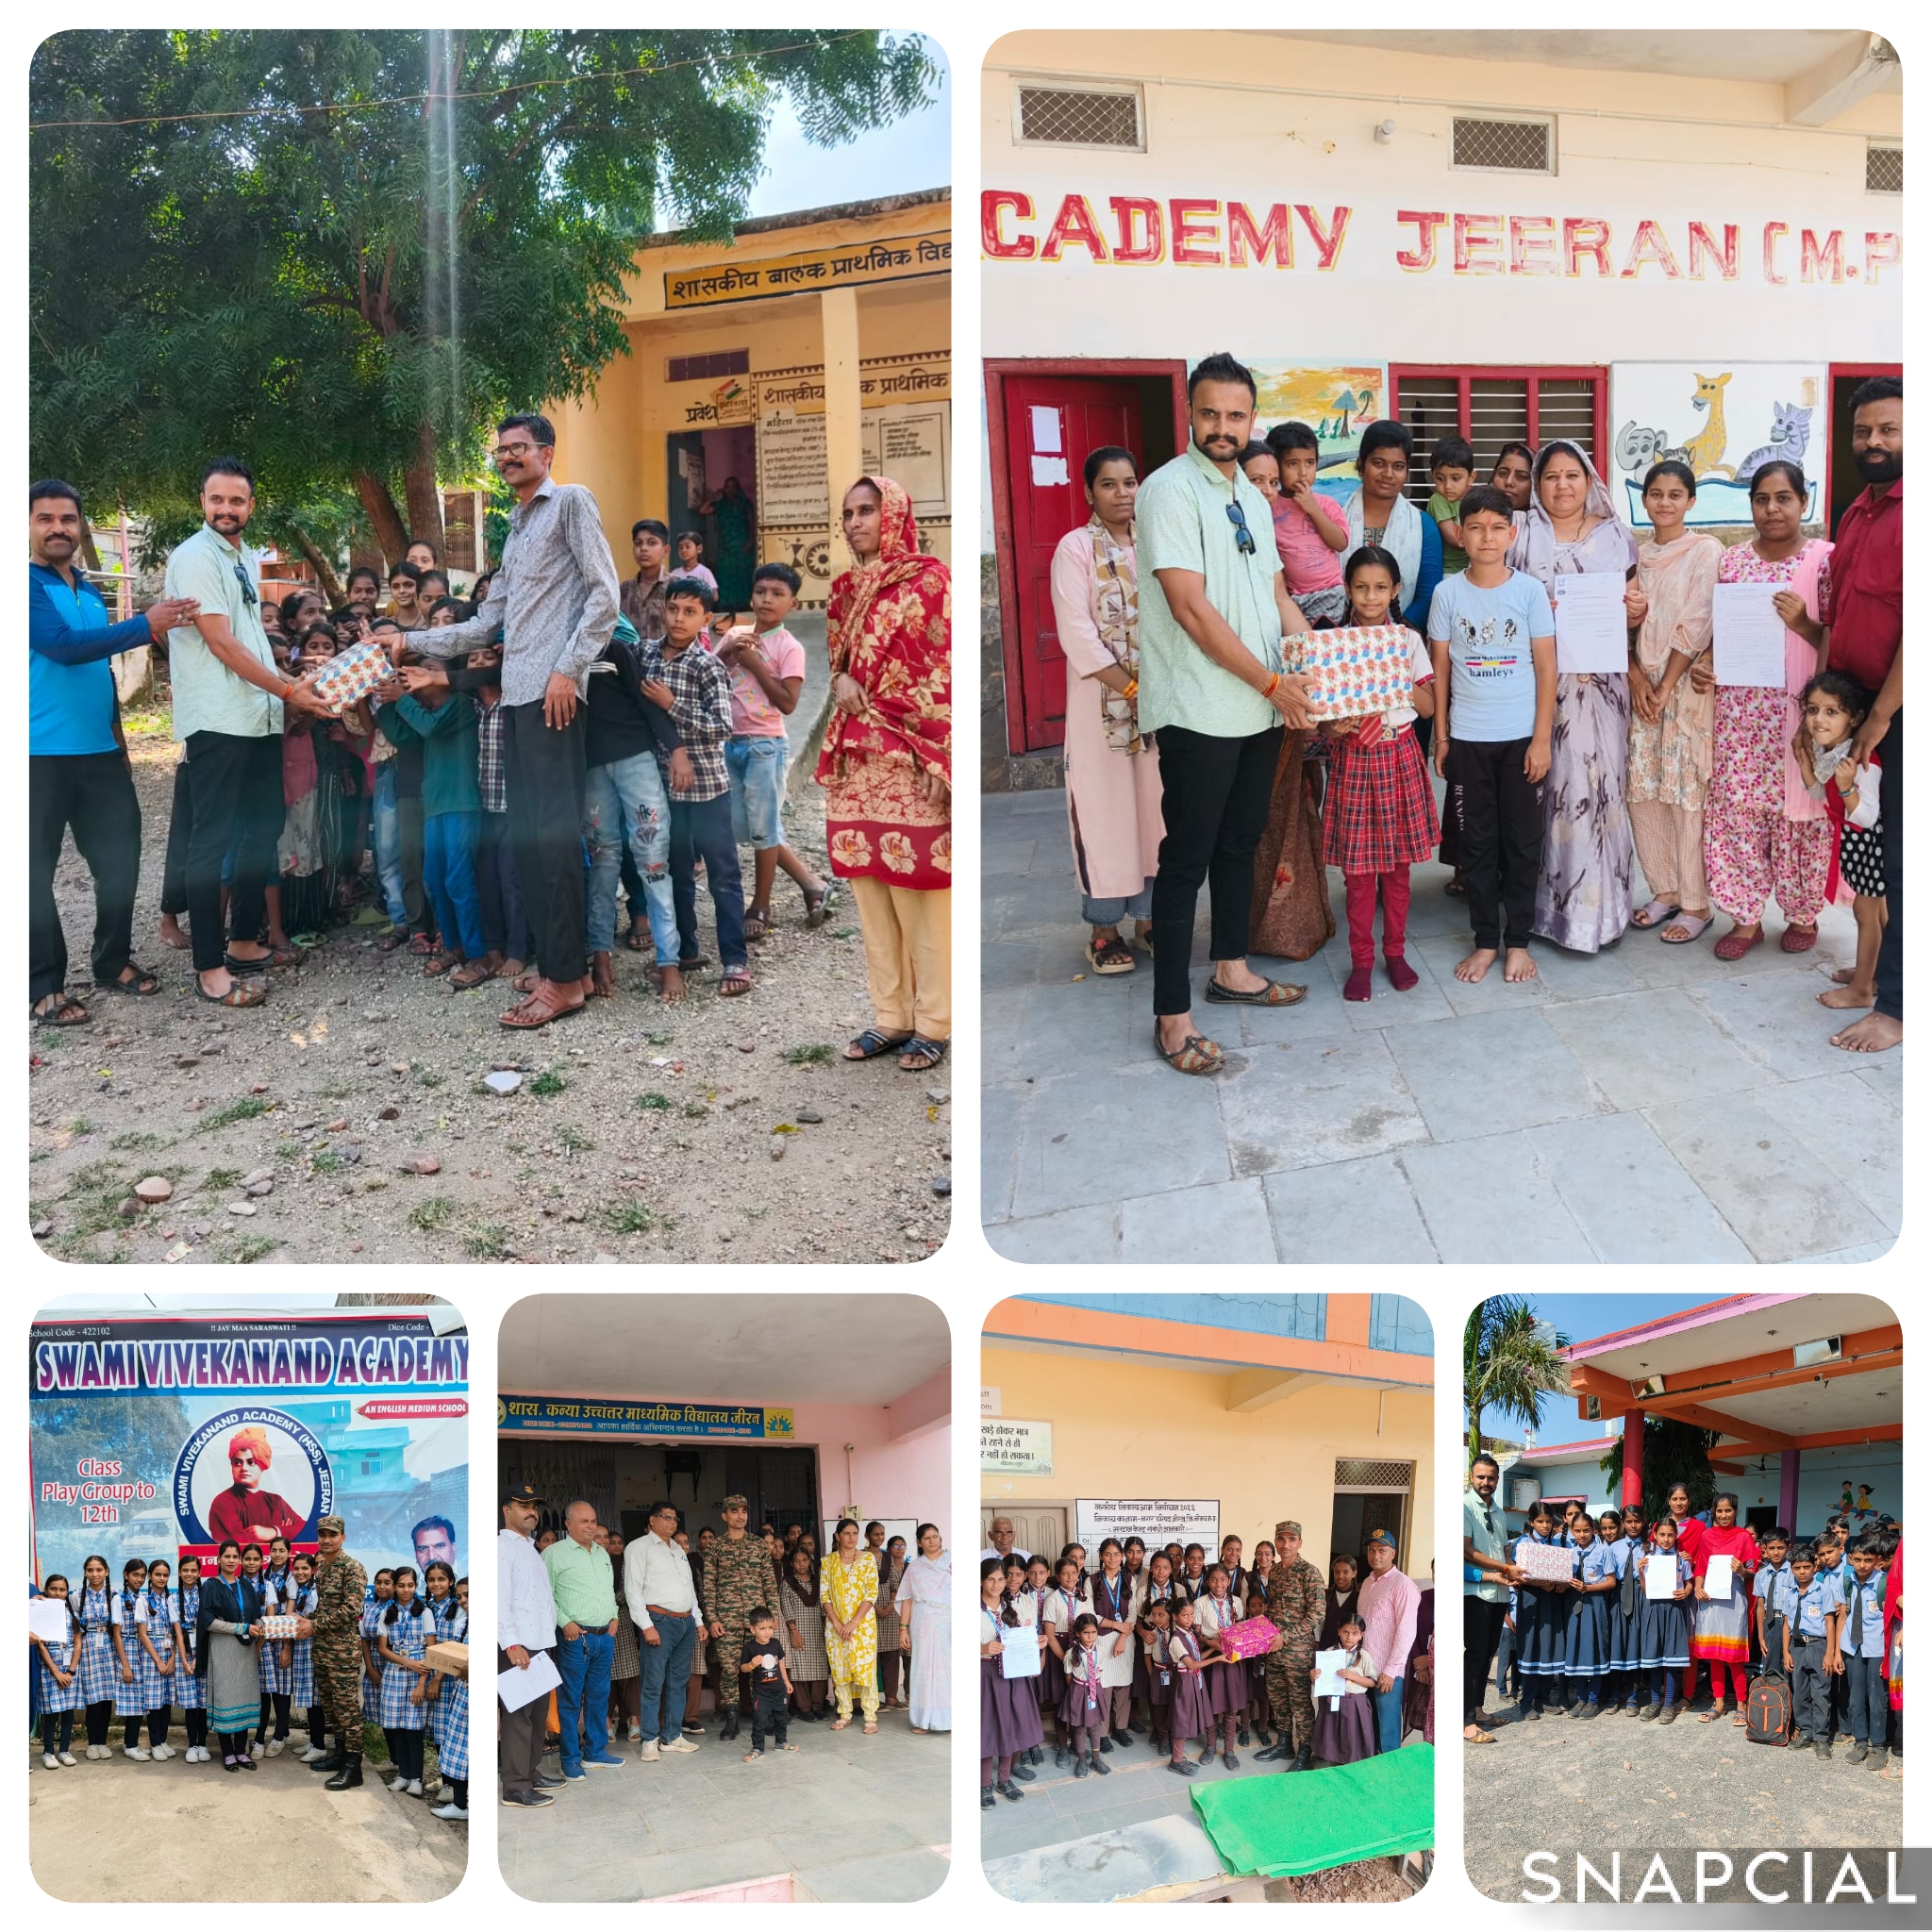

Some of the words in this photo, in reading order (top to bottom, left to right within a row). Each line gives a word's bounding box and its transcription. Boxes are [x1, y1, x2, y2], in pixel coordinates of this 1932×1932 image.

[981, 189, 1353, 271] CADEMY
[1396, 209, 1741, 280] JEERAN
[673, 267, 759, 299] शासकीय
[766, 262, 827, 285] बालक
[831, 245, 911, 277] प्राथमिक
[764, 381, 825, 405] शासकीय
[881, 368, 949, 395] प्राथमिक
[1470, 667, 1513, 678] hamleys
[29, 1327, 54, 1338] School
[55, 1328, 75, 1337] Code
[82, 1327, 110, 1336] 422102
[36, 1341, 139, 1391] SWAMI
[139, 1338, 334, 1389] VIVEKANAND
[334, 1336, 469, 1386] ACADEMY
[365, 1405, 376, 1414] AN
[377, 1405, 407, 1413] ENGLISH
[408, 1404, 437, 1413] MEDIUM
[438, 1404, 466, 1412] SCHOOL
[508, 1401, 542, 1416] शास.
[546, 1404, 580, 1418] कन्या
[626, 1404, 682, 1422] माध्यमिक
[684, 1405, 728, 1424] विद्यालय
[730, 1407, 760, 1424] जीरन
[242, 1410, 302, 1435] ACADEMY
[621, 1422, 641, 1431] हार्दिक
[642, 1423, 675, 1432] अभिनन्दन
[676, 1424, 693, 1433] करता
[981, 1424, 994, 1436] खड़े
[995, 1425, 1014, 1436] होकर
[1016, 1427, 1029, 1436] मात्र
[181, 1413, 240, 1472] VIVEKANAND
[986, 1449, 999, 1458] नहीं
[1001, 1450, 1008, 1459] हो
[989, 1437, 1003, 1447] रहने
[1005, 1438, 1011, 1447] से
[1013, 1438, 1021, 1448] ही
[78, 1458, 121, 1476] Class
[42, 1482, 78, 1505] Play
[81, 1482, 134, 1504] Group
[136, 1481, 155, 1499] to
[179, 1474, 190, 1517] SWAMI
[318, 1467, 331, 1514] JEERAN
[81, 1505, 118, 1524] 12th
